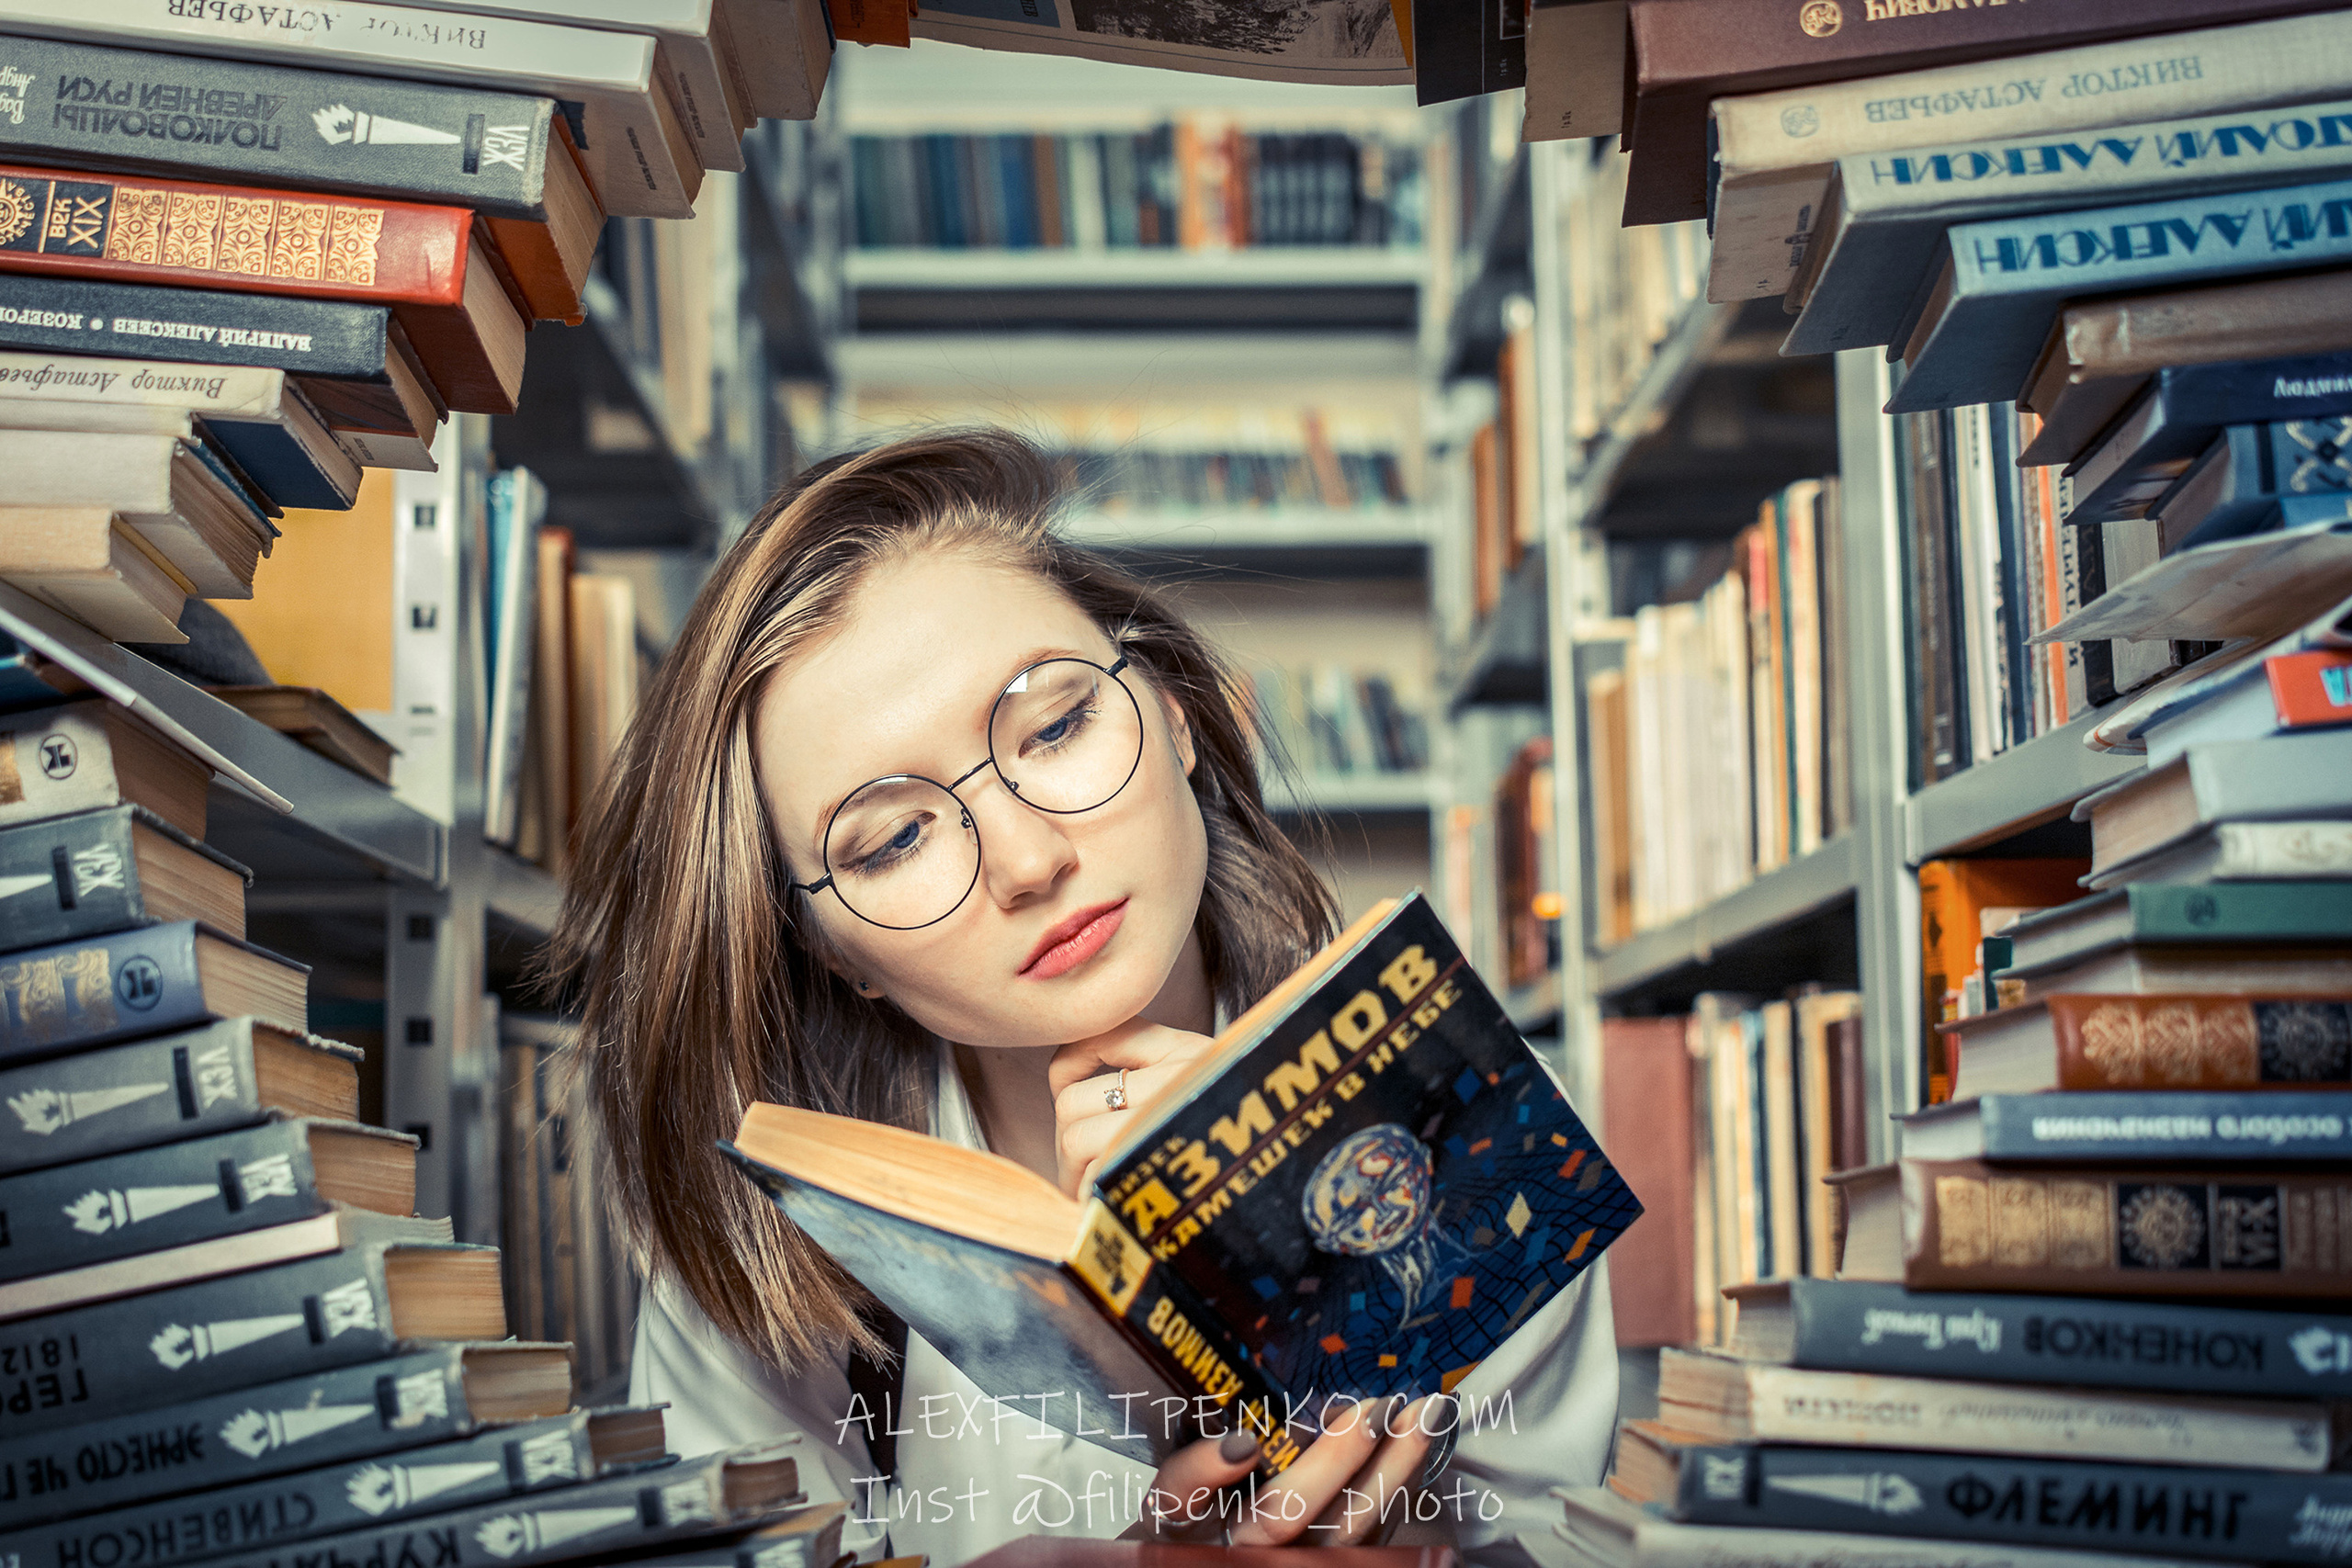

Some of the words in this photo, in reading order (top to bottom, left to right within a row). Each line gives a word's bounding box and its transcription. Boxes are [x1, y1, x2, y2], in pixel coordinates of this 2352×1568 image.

[56, 74, 135, 107] РУСИ
[2062, 54, 2205, 96] ВИКТОР
[139, 82, 288, 121] ДРЕВНЕЙ
[1864, 77, 2046, 125] АСТАФЬЕВ
[53, 102, 282, 152] ПОЛКОВОДЦЫ
[483, 123, 531, 173] ЖЗЛ
[1872, 136, 2143, 186] АЛЕКСИН
[67, 195, 107, 250] XIX
[1974, 207, 2256, 275] АЛЕКСИН
[0, 306, 84, 331] КОЗЕРО
[111, 318, 218, 342] АЛЕКСЕЕВ
[218, 327, 312, 354] ВАЛЕРИЙ
[131, 367, 228, 399] Виктор
[196, 1044, 239, 1110] ЖЗЛ
[1123, 943, 1439, 1239] АЗИМОВ
[1150, 1097, 1335, 1263] КАМЕШЕК
[1333, 1073, 1367, 1101] В
[1365, 979, 1464, 1075] НЕБЕ
[1, 1334, 79, 1376] 1812
[1147, 1295, 1245, 1407] АЗИМОВ
[0, 1367, 89, 1416] ГЕР
[27, 1453, 70, 1497] ЧЕ
[76, 1422, 208, 1486] ЭРНЕСТО
[55, 1491, 319, 1568] СТИВЕНСОН
[1946, 1472, 2247, 1542] ФЛЕМИНГ
